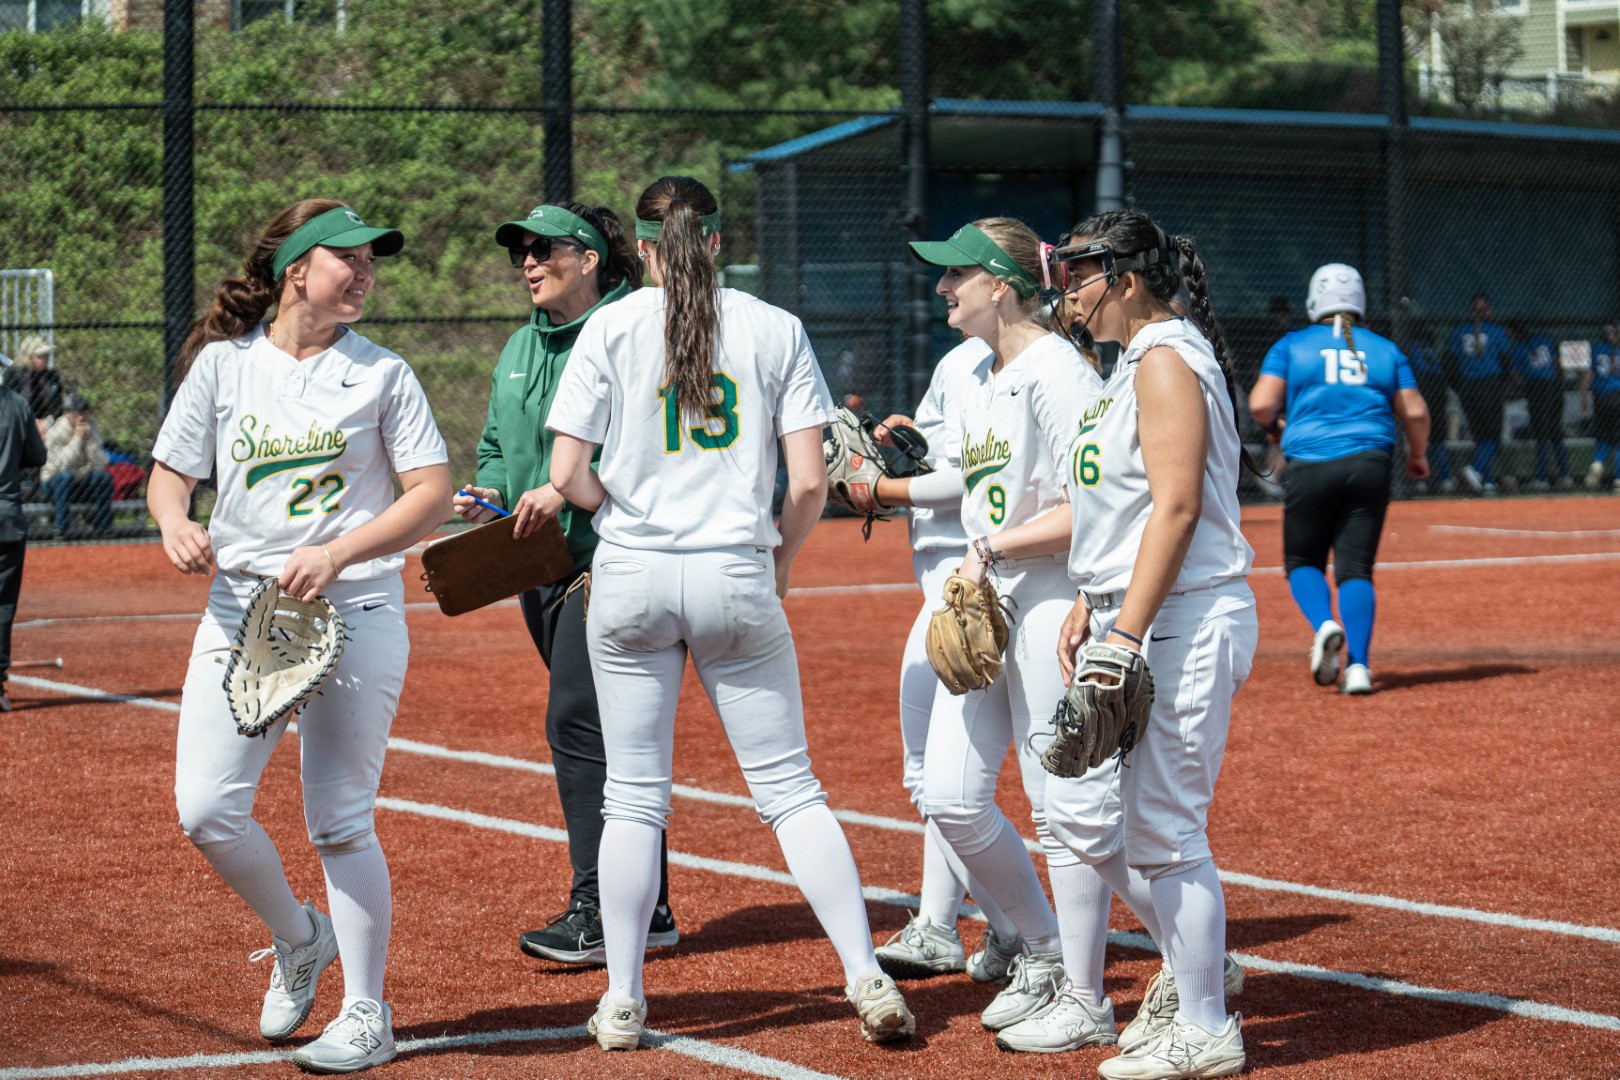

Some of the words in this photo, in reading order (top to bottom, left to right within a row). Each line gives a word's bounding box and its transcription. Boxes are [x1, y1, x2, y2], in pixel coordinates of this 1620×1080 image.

[1320, 348, 1367, 385] 15
[657, 370, 741, 454] 13
[231, 414, 347, 463] Shoreline
[1073, 441, 1102, 489] 16
[287, 471, 346, 519] 22
[986, 483, 1006, 526] 9
